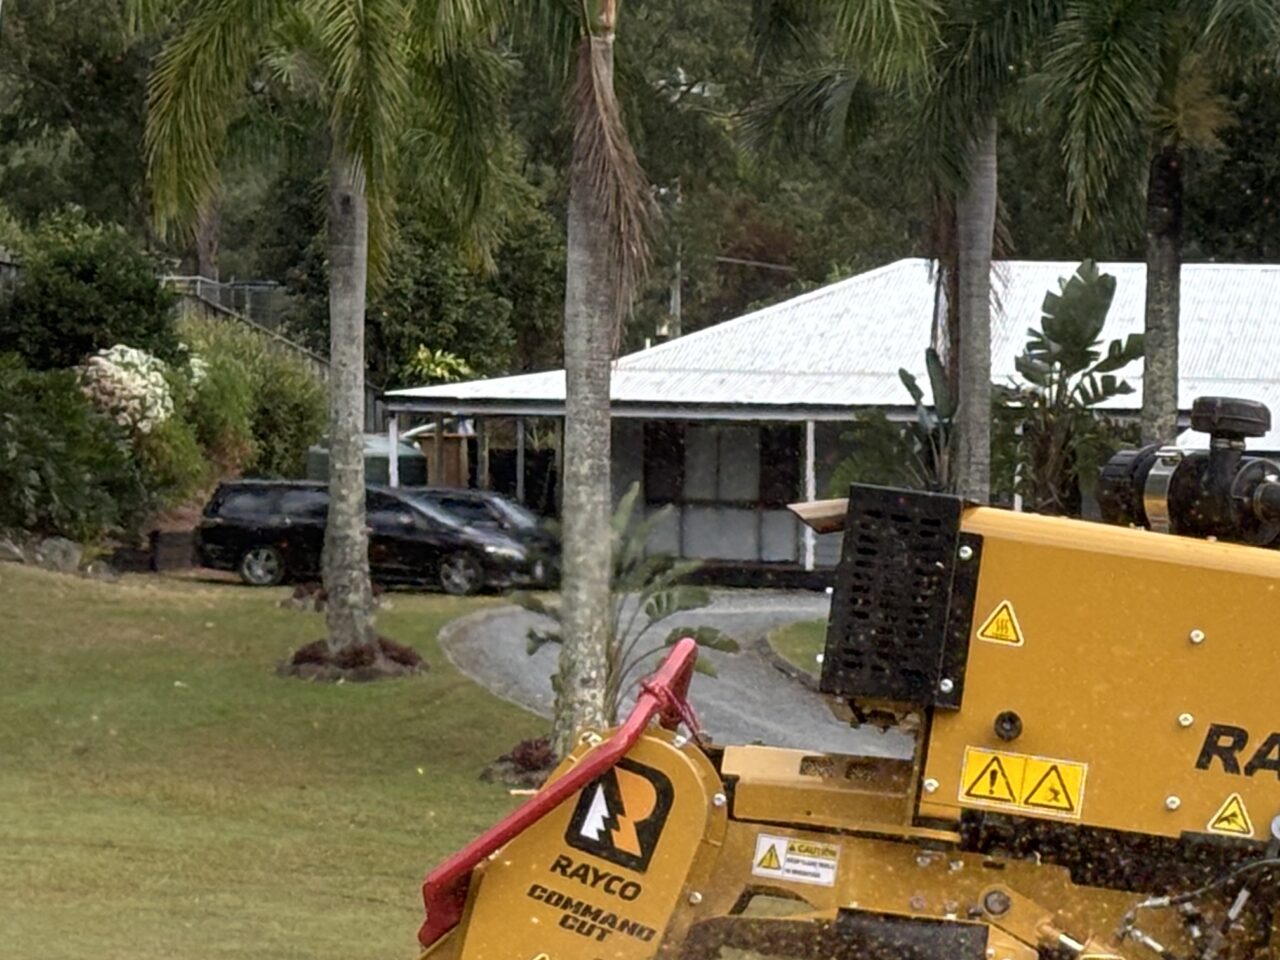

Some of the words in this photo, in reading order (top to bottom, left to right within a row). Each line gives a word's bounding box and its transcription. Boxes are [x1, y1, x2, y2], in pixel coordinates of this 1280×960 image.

[550, 854, 642, 901] RAYCO
[527, 884, 657, 941] COMMAND
[559, 914, 614, 941] CUT
